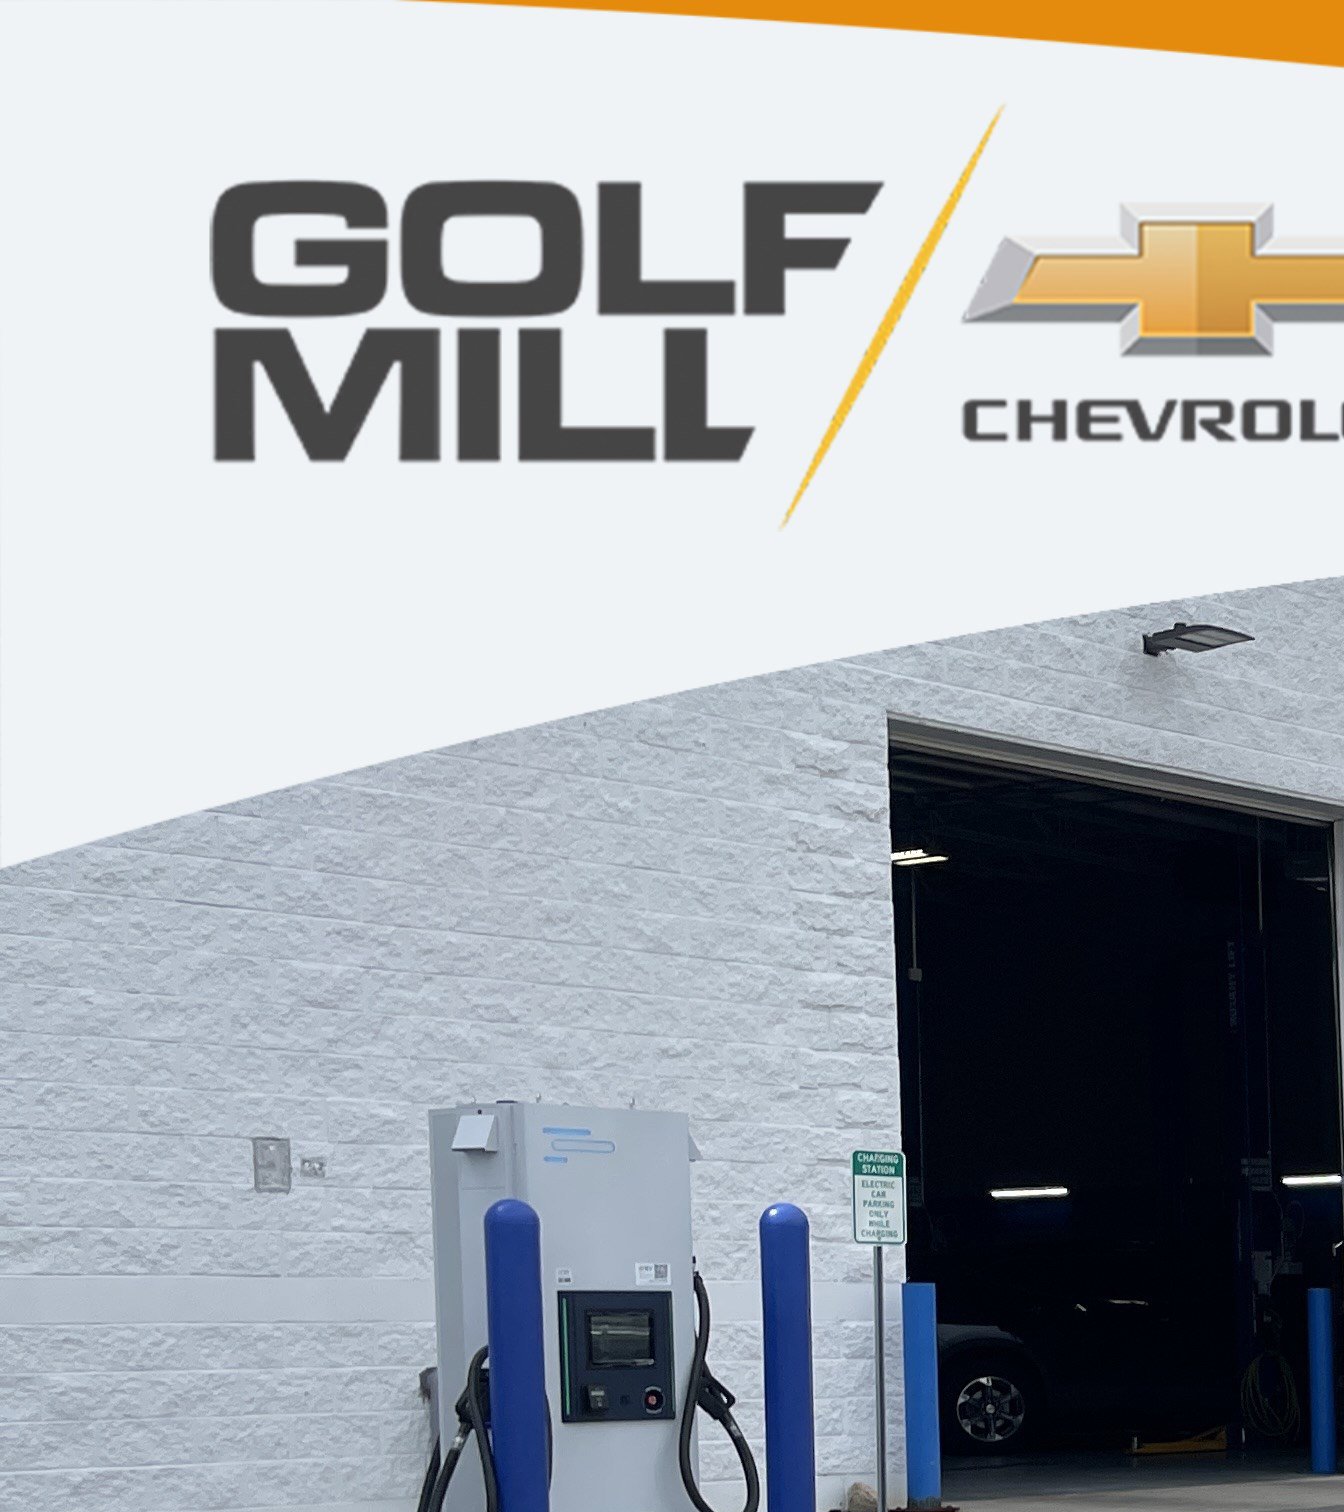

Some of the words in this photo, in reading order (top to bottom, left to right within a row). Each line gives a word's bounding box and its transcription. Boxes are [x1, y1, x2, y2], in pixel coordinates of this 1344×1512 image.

[857, 1153, 899, 1164] CHARGING
[861, 1164, 895, 1174] STATION
[861, 1180, 895, 1190] ELECTRIC
[870, 1190, 886, 1198] CAR
[862, 1199, 895, 1208] PARKING
[868, 1210, 888, 1218] ONLY
[868, 1220, 890, 1228] WHILE
[861, 1229, 899, 1238] CHARGING
